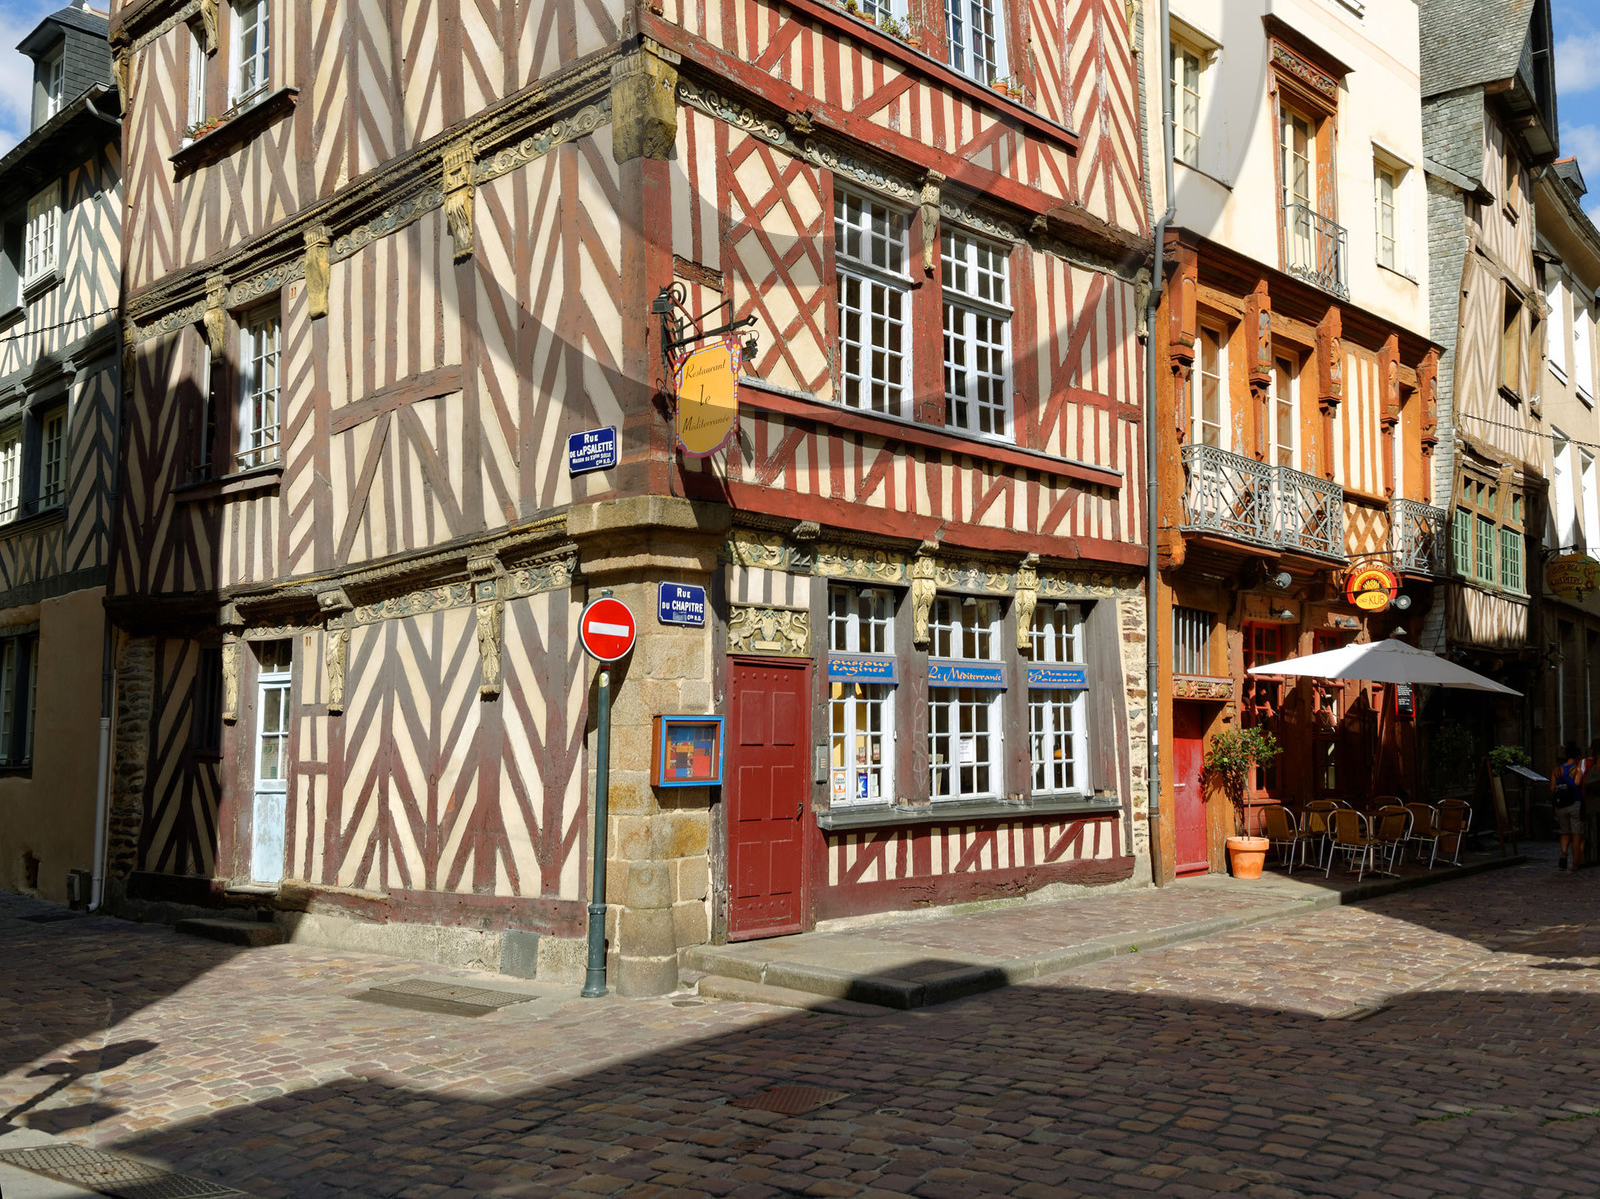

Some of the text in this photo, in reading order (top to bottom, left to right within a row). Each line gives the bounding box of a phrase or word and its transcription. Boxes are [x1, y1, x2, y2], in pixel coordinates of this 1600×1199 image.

[685, 359, 726, 380] Restaurant
[583, 441, 613, 455] PSALETTE
[1369, 594, 1385, 605] KUB
[672, 600, 704, 613] CHAPITRE
[833, 664, 885, 676] tagines
[928, 666, 941, 679] Le
